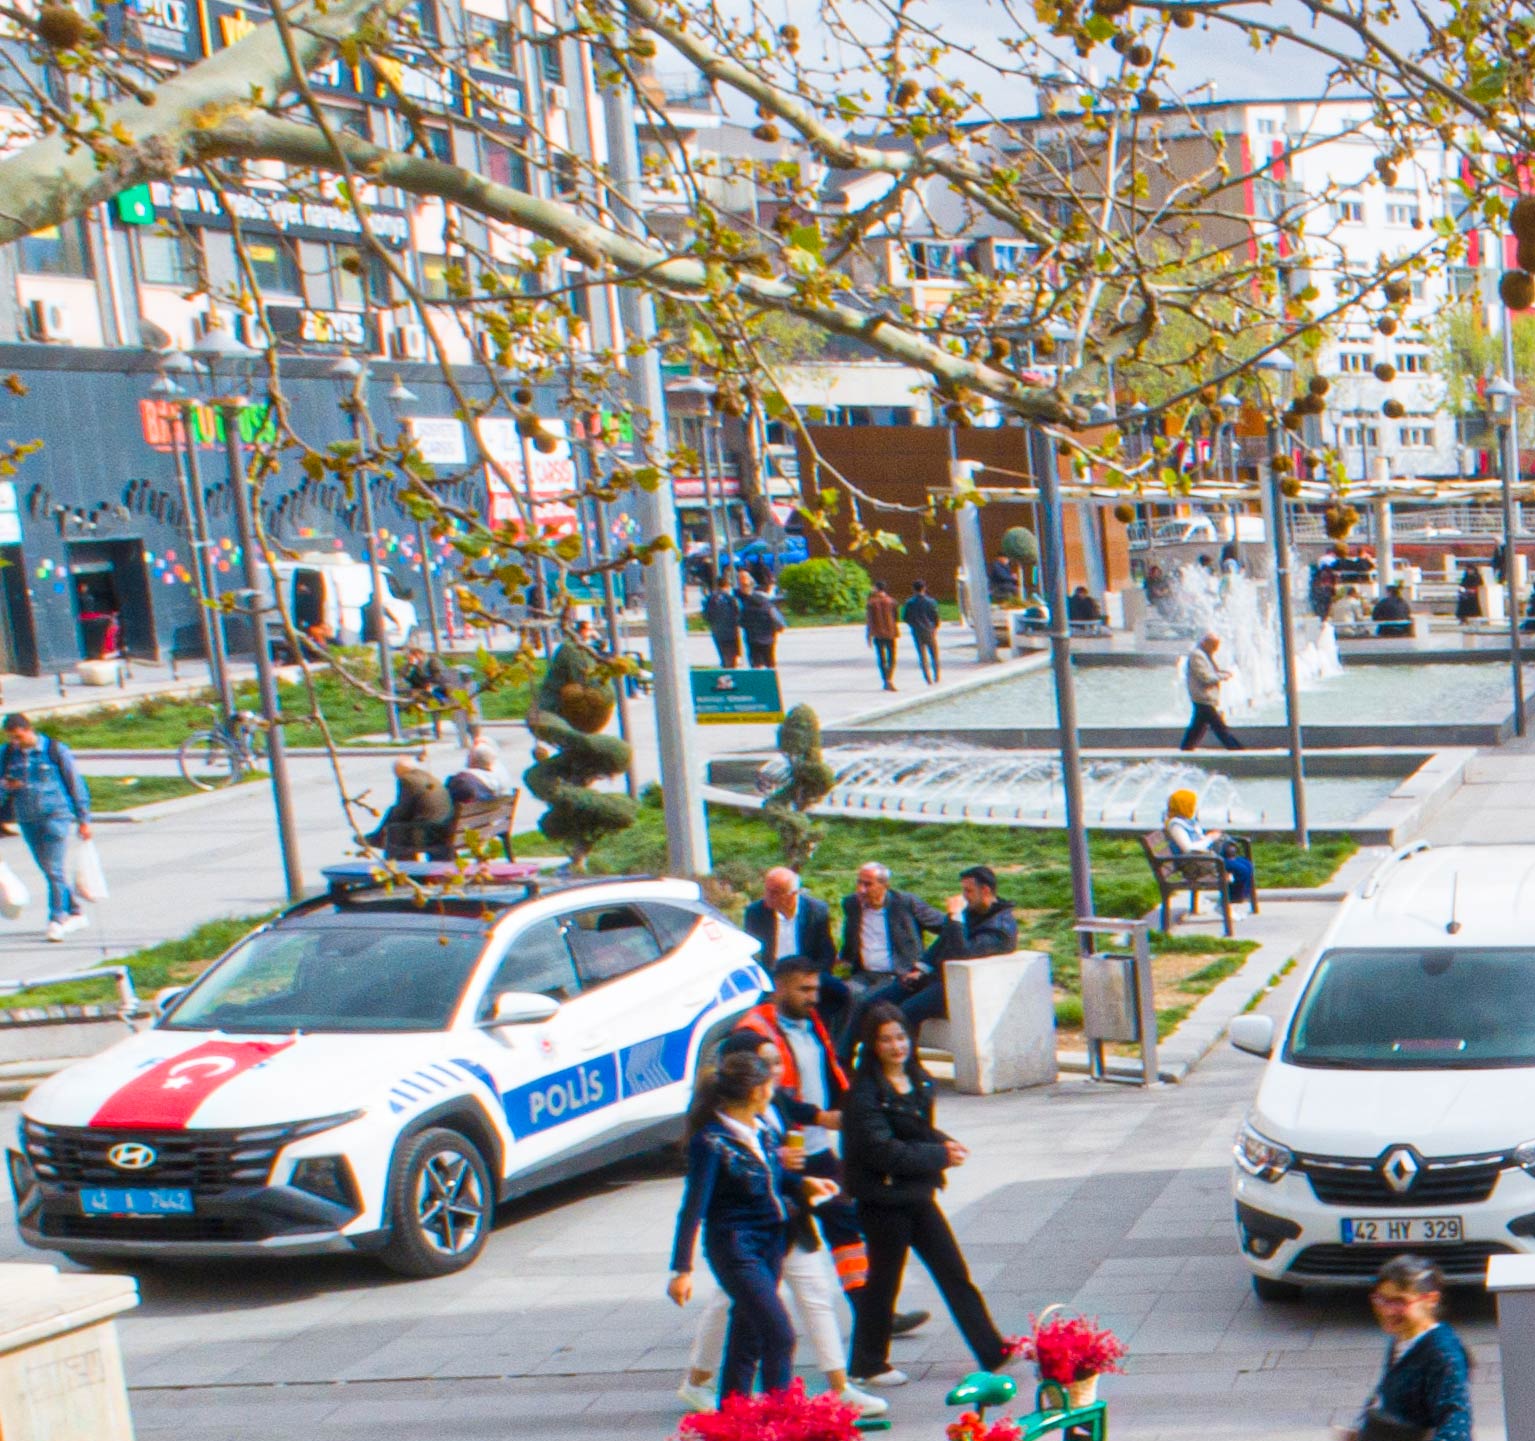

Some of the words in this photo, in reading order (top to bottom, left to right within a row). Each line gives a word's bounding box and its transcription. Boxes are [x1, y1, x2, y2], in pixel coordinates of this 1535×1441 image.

[529, 1066, 603, 1124] POLİS
[1355, 1222, 1378, 1240] 42
[1388, 1221, 1411, 1239] HY
[1424, 1220, 1459, 1239] 329
